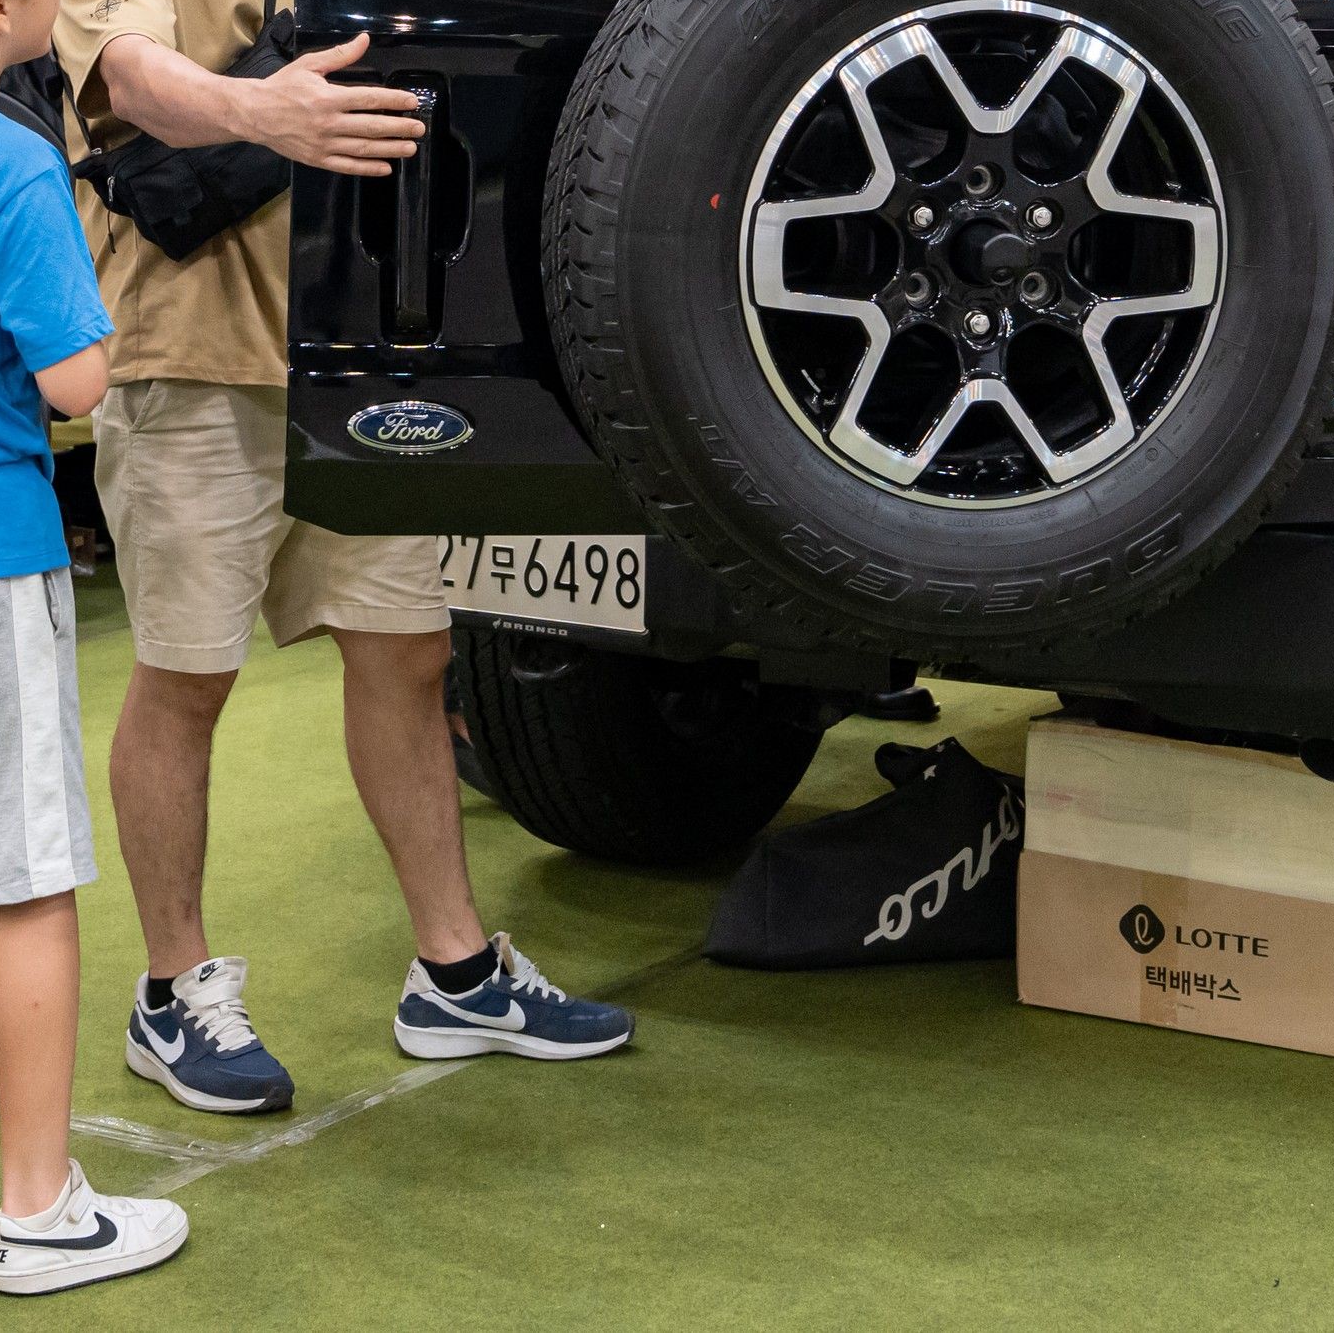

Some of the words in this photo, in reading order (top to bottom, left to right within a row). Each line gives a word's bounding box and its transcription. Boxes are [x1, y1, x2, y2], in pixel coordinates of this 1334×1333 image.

[377, 413, 446, 442] Ford
[502, 621, 568, 637] BRONCO
[1175, 925, 1269, 958] LOTTE
[1145, 965, 1242, 1002] 택배박스
